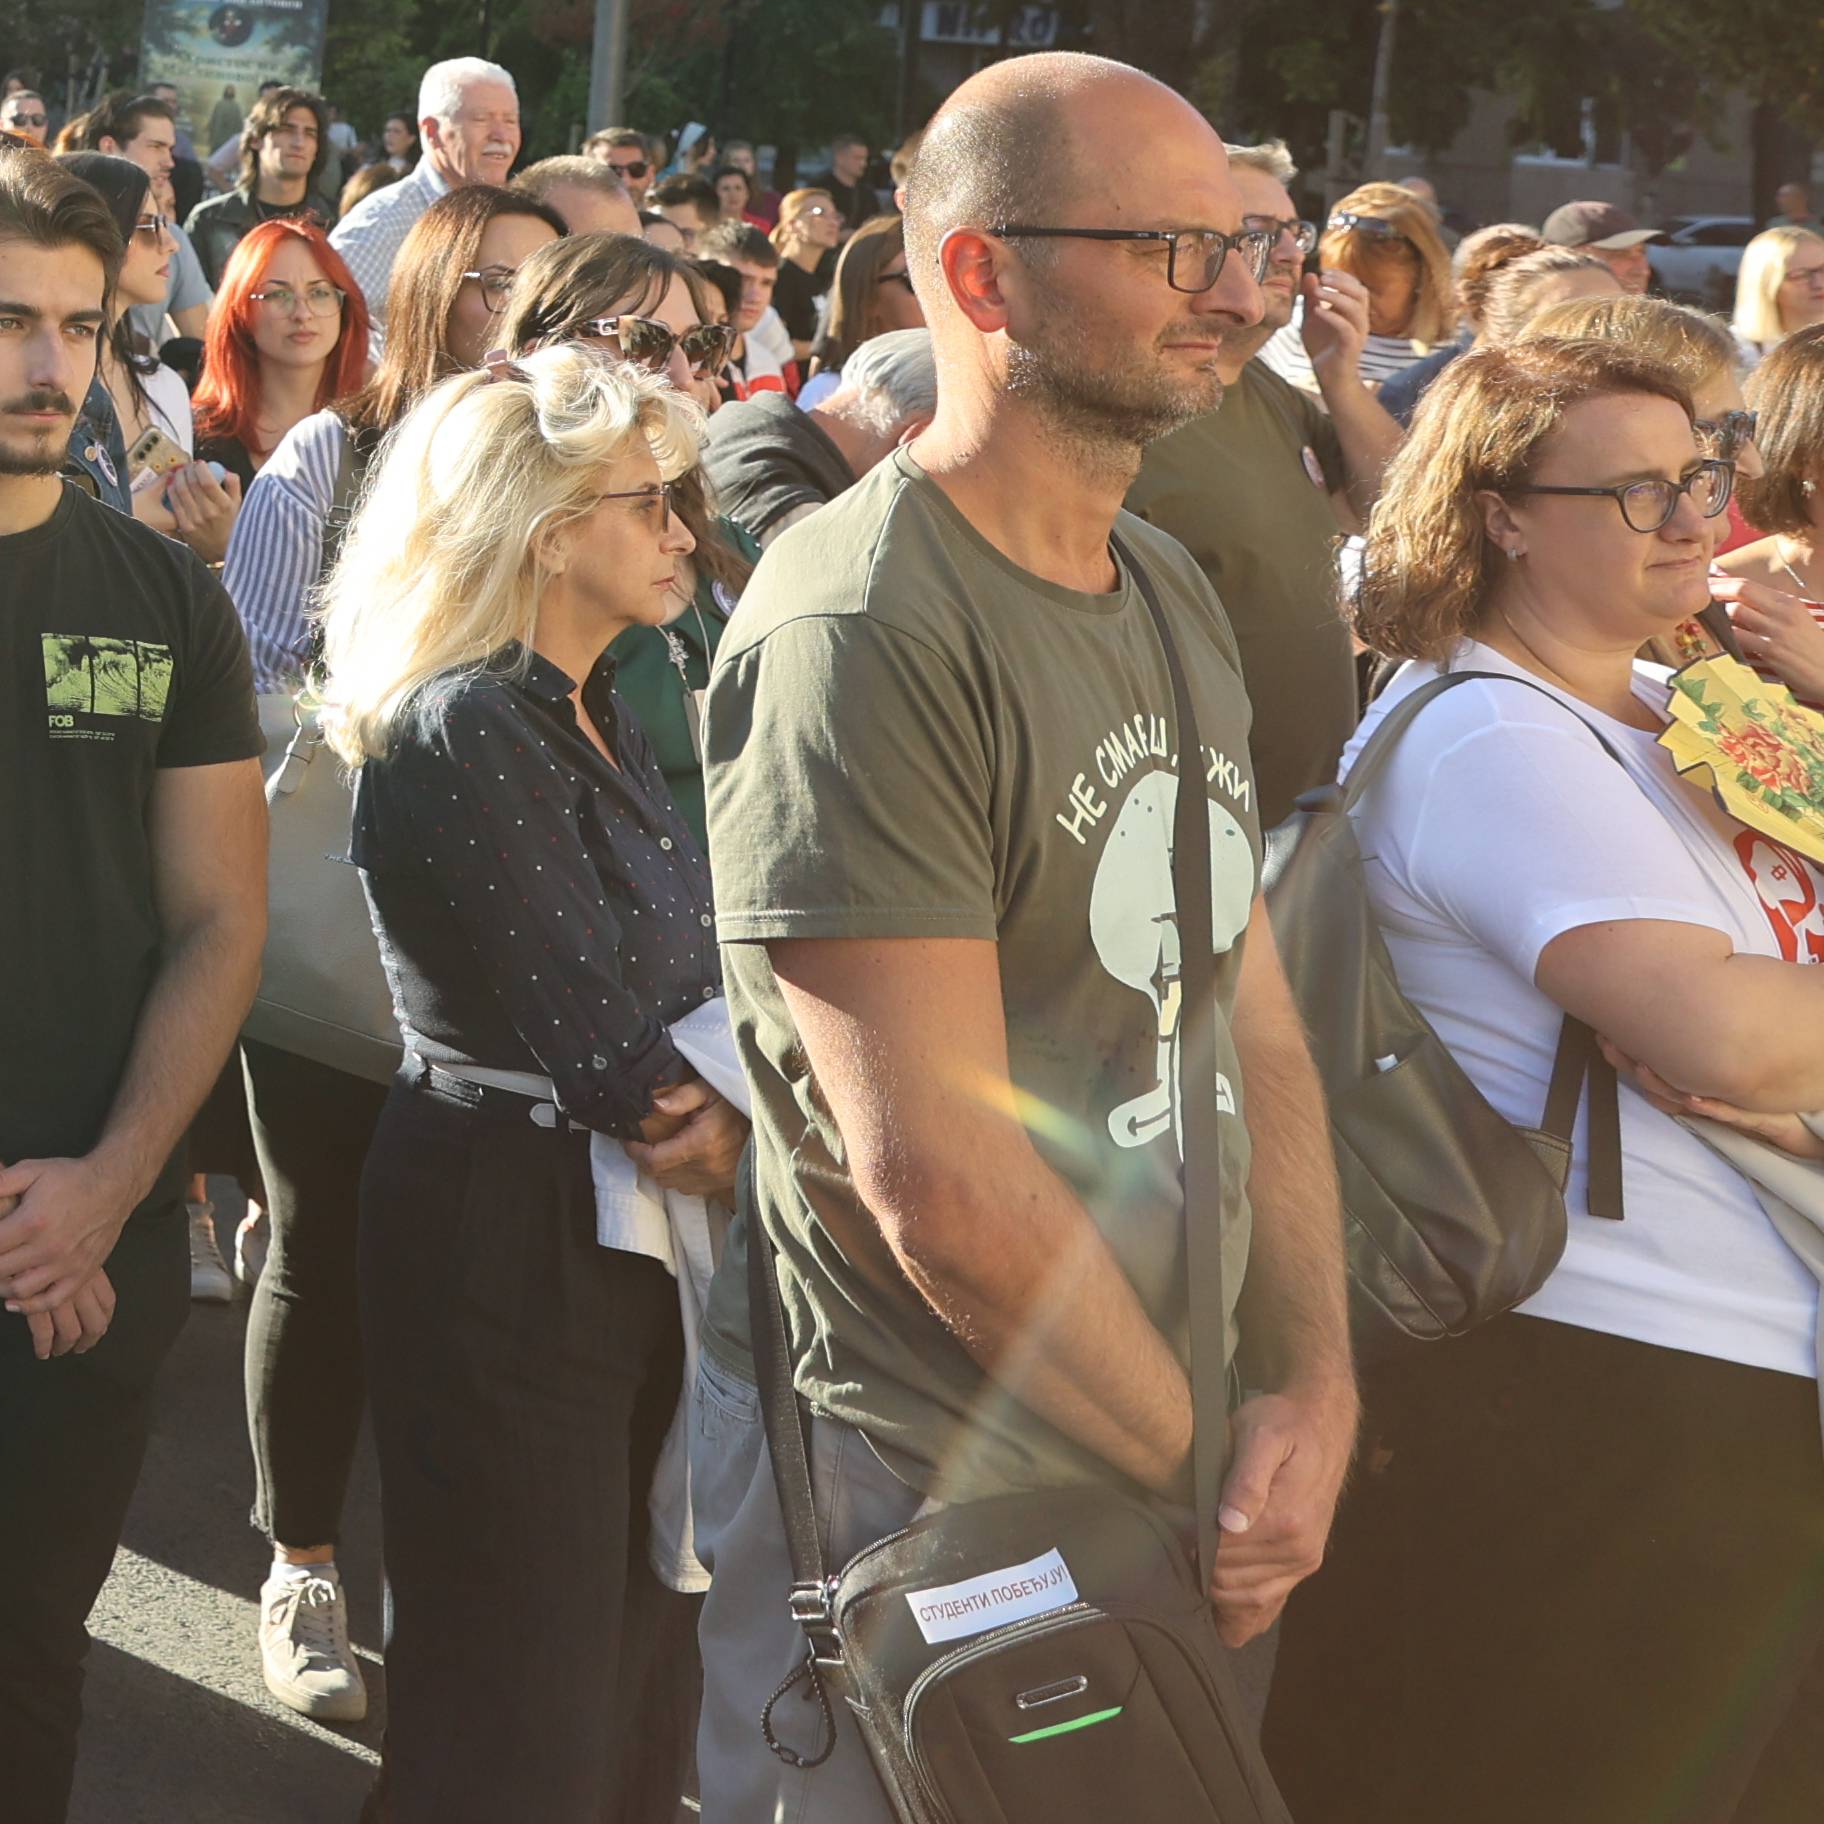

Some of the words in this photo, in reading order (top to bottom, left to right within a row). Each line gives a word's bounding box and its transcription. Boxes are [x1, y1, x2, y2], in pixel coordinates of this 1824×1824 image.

[48, 714, 73, 727] FOB
[1056, 772, 1107, 845] НЕ
[919, 1591, 991, 1622] СТУДЕНТИ
[992, 1564, 1068, 1604] ПОБЕЂУЈУ!
